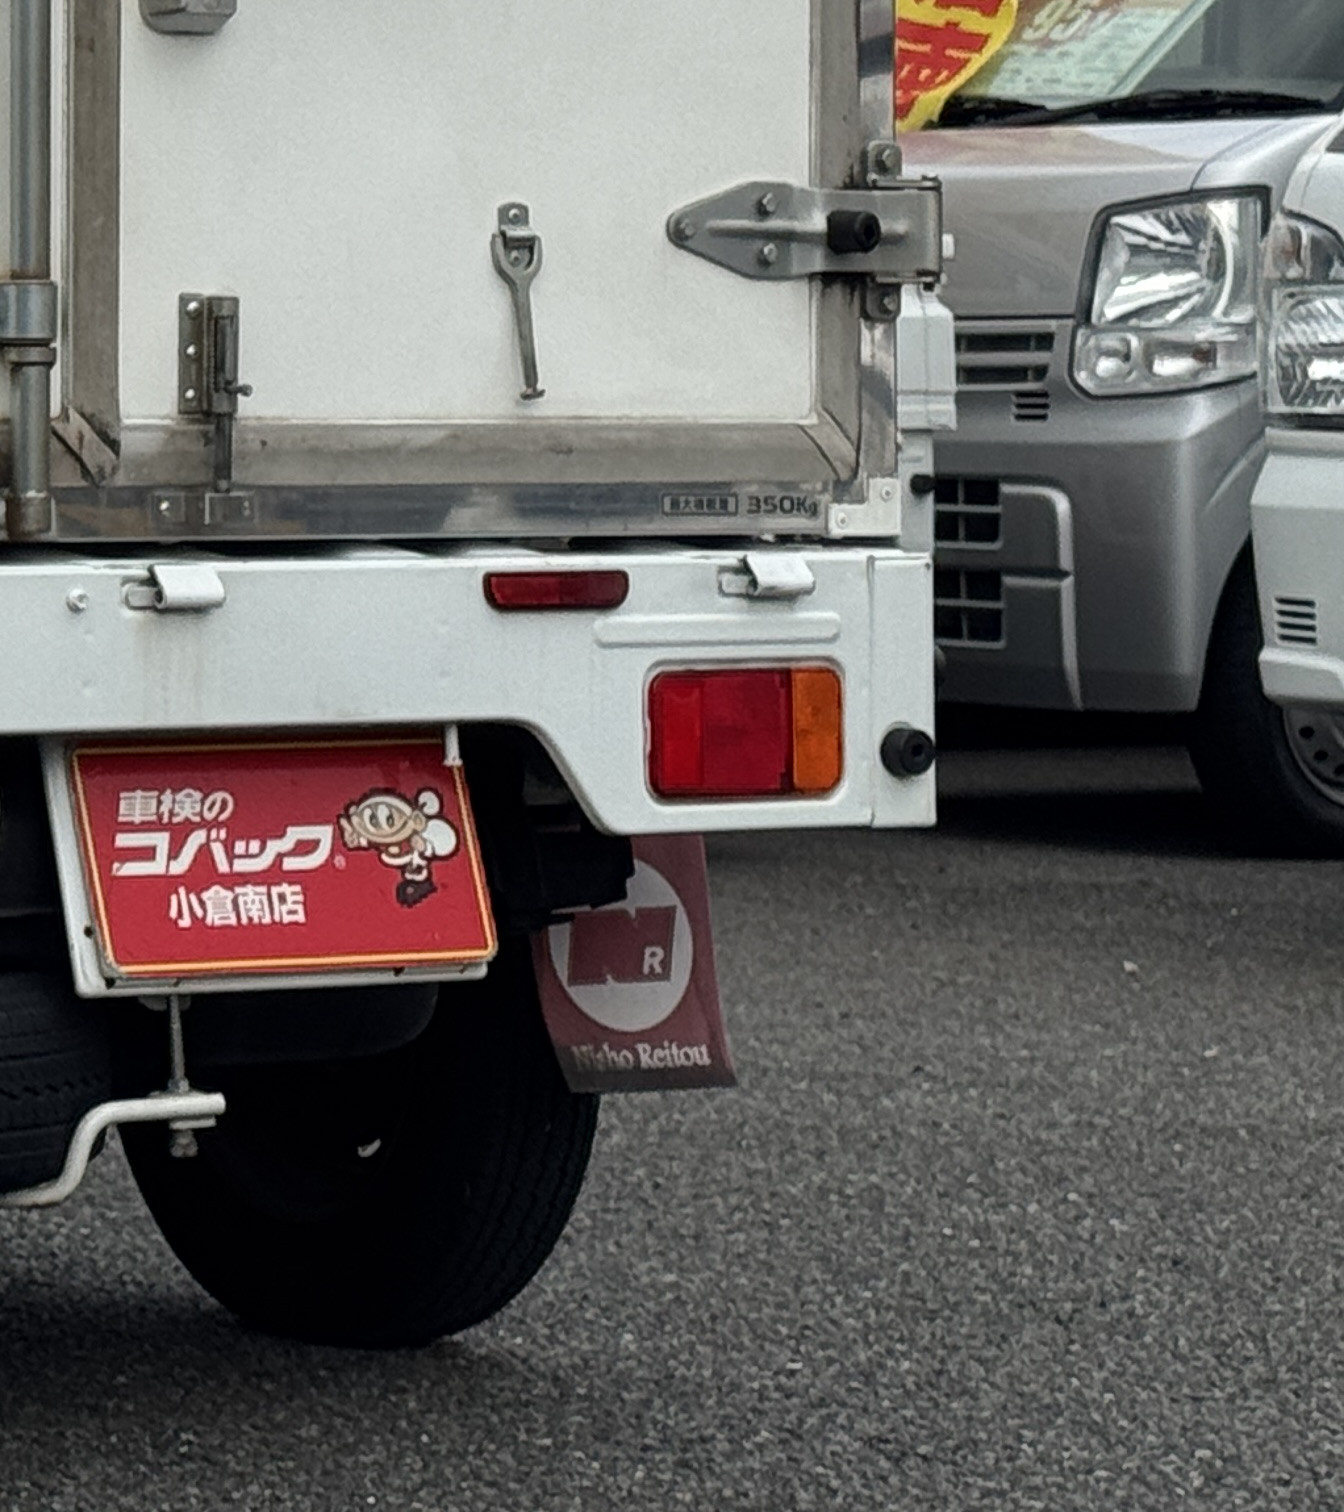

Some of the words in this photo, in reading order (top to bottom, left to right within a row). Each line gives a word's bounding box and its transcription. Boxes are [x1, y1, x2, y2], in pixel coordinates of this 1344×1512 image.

[116, 789, 235, 825] 車検の
[112, 824, 334, 876] コバック
[168, 883, 307, 927] 小倉南店
[635, 1039, 712, 1069] Reitou
